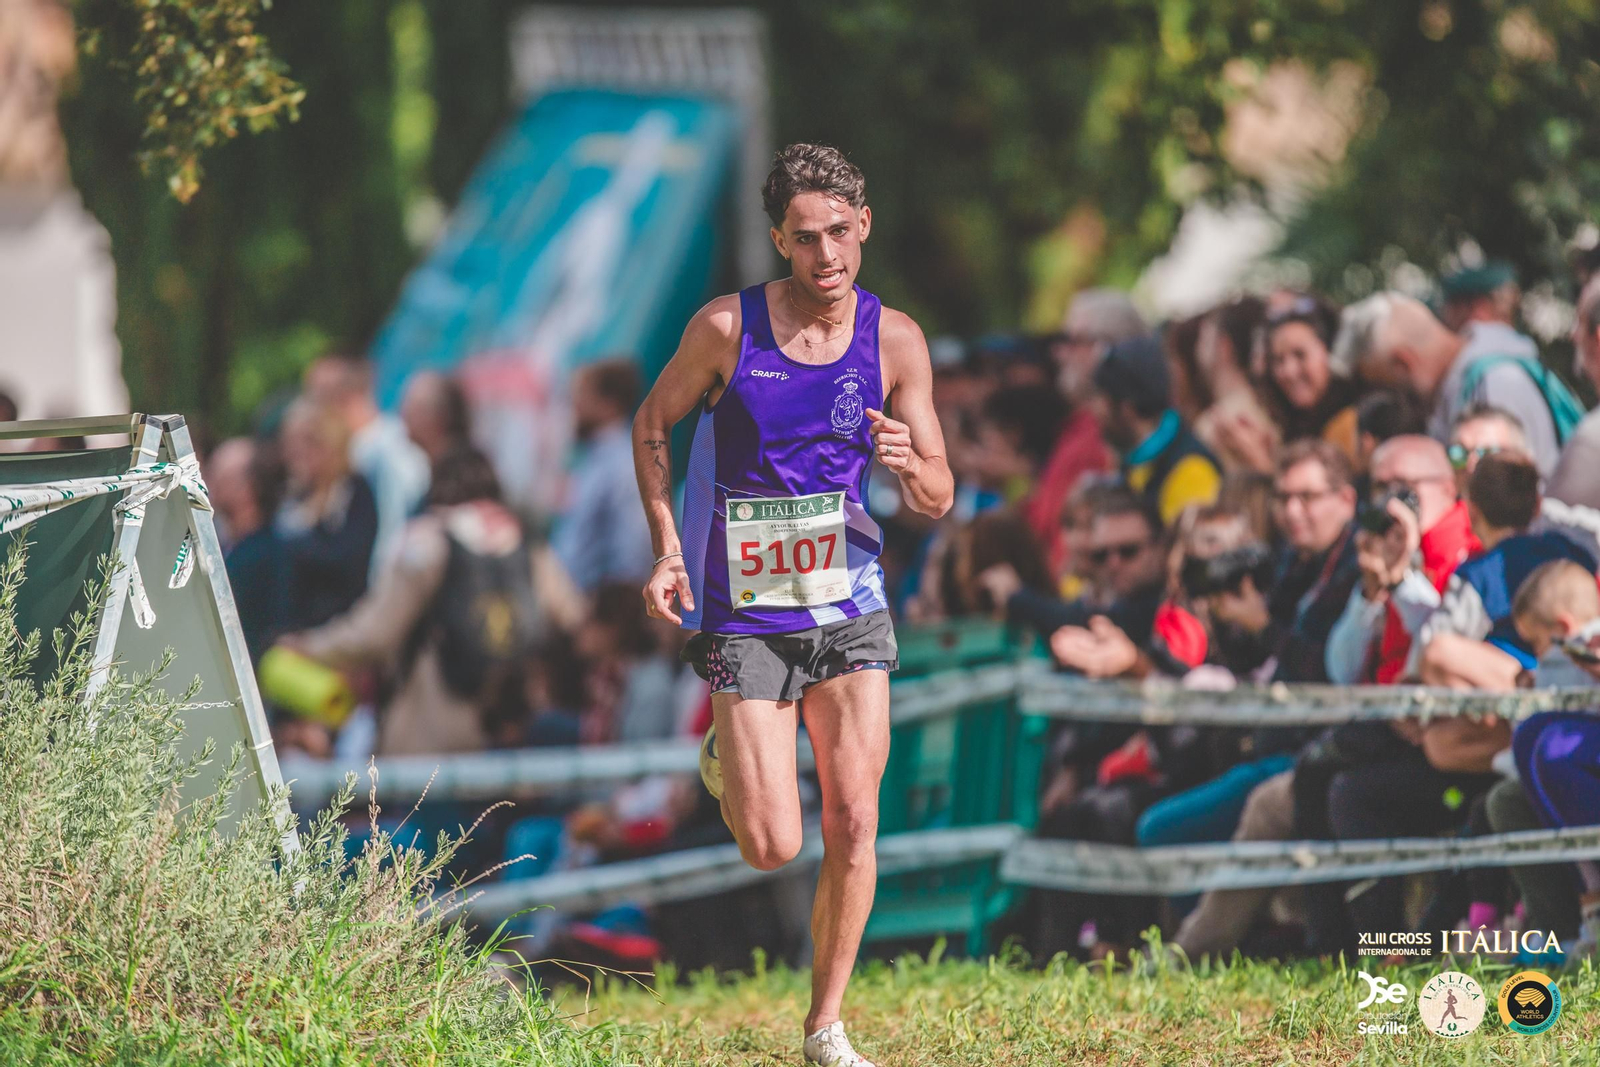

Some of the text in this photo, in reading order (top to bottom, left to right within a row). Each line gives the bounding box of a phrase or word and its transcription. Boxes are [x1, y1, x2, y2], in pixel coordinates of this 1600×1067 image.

[751, 369, 781, 379] CRAFT
[762, 501, 817, 517] ITÁLICA
[740, 533, 837, 577] 5107
